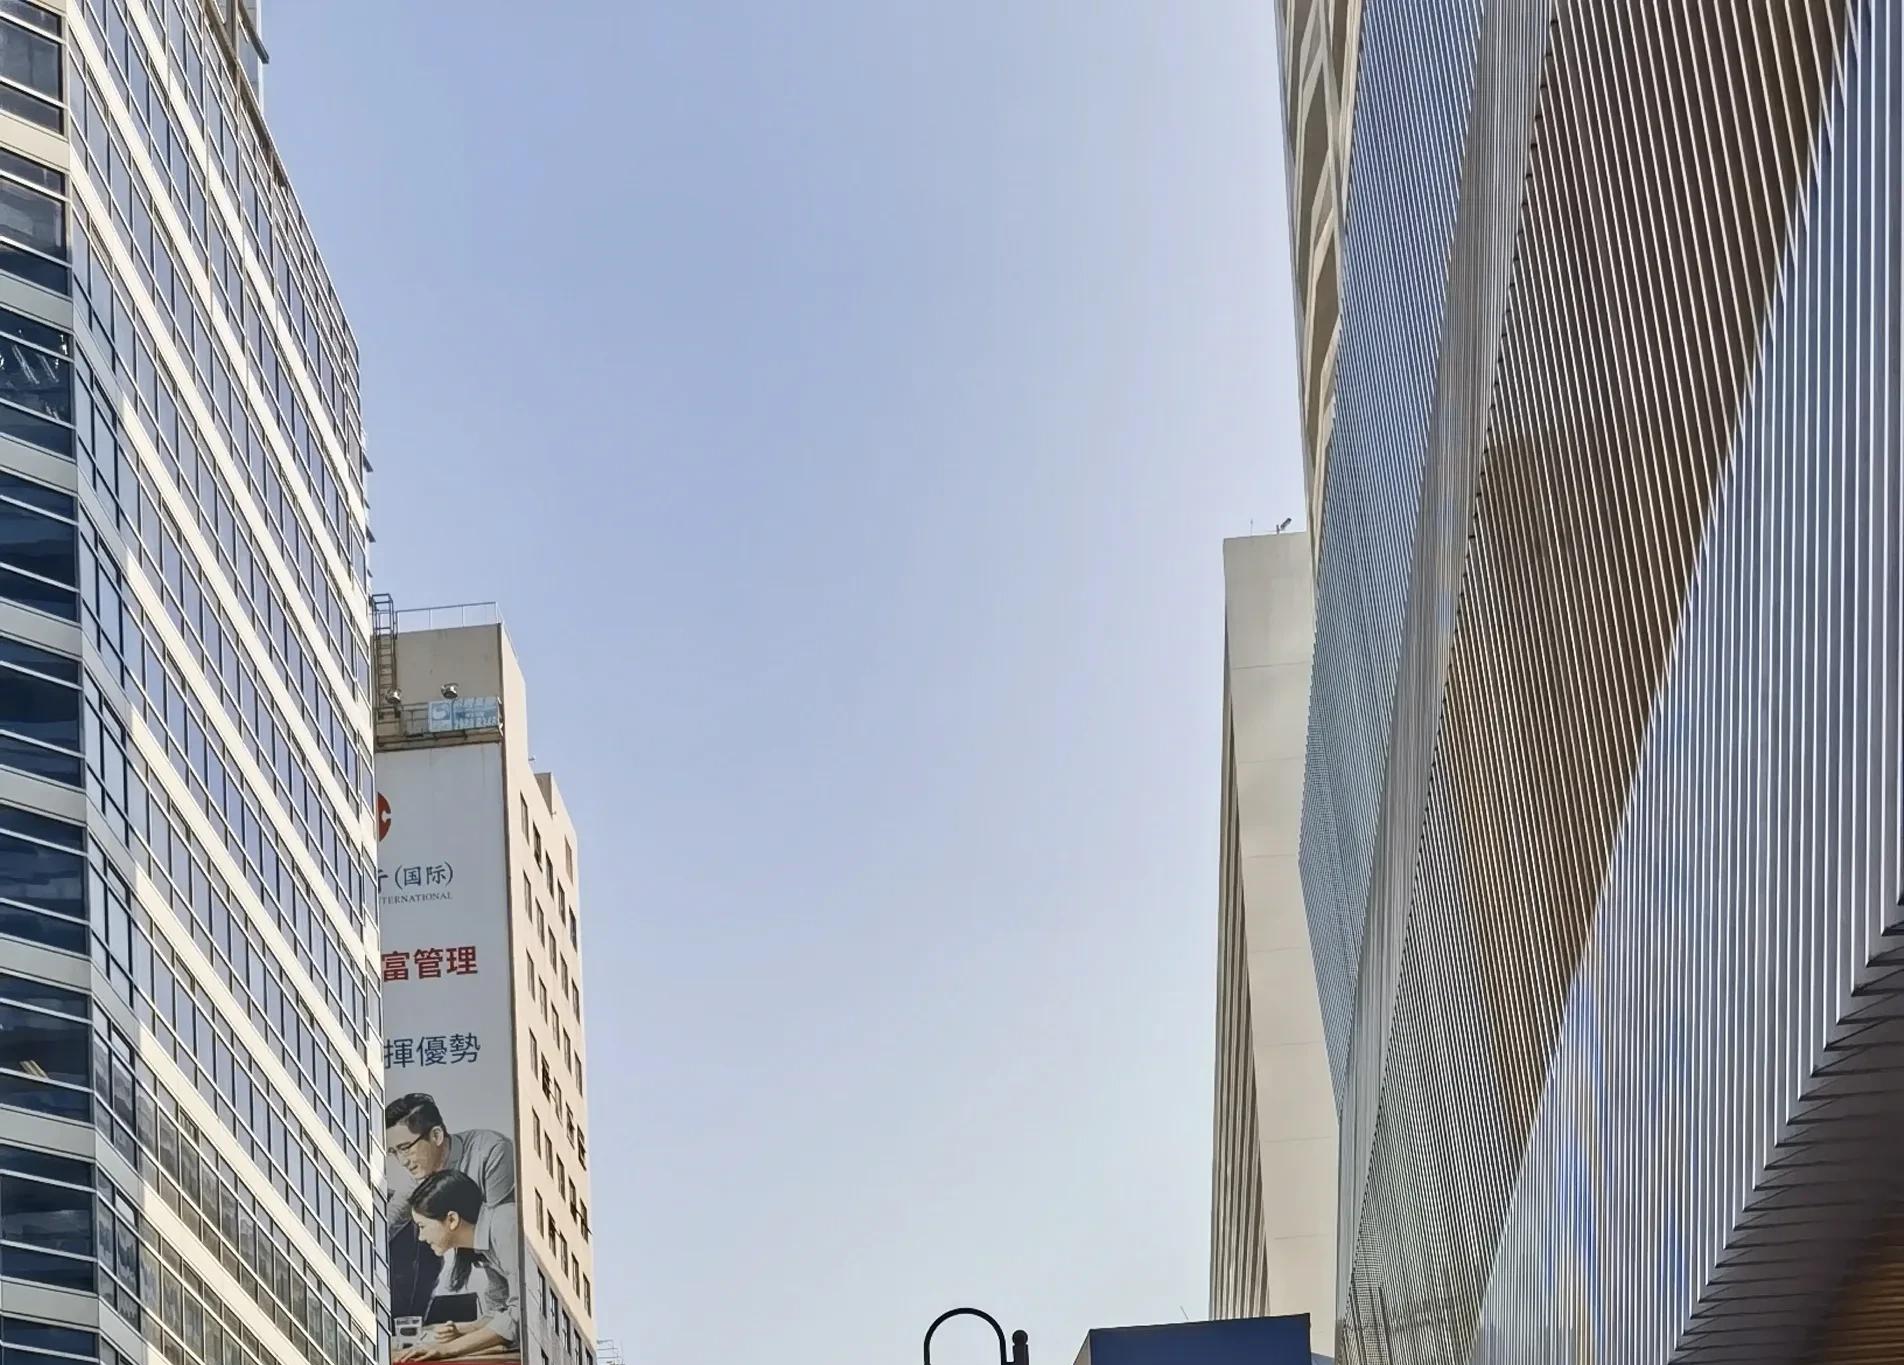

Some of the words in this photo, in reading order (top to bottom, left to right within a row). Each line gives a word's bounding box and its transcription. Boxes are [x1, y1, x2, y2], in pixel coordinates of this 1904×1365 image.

[380, 945, 479, 982] 富管理
[383, 1032, 482, 1069] 揮優勢
